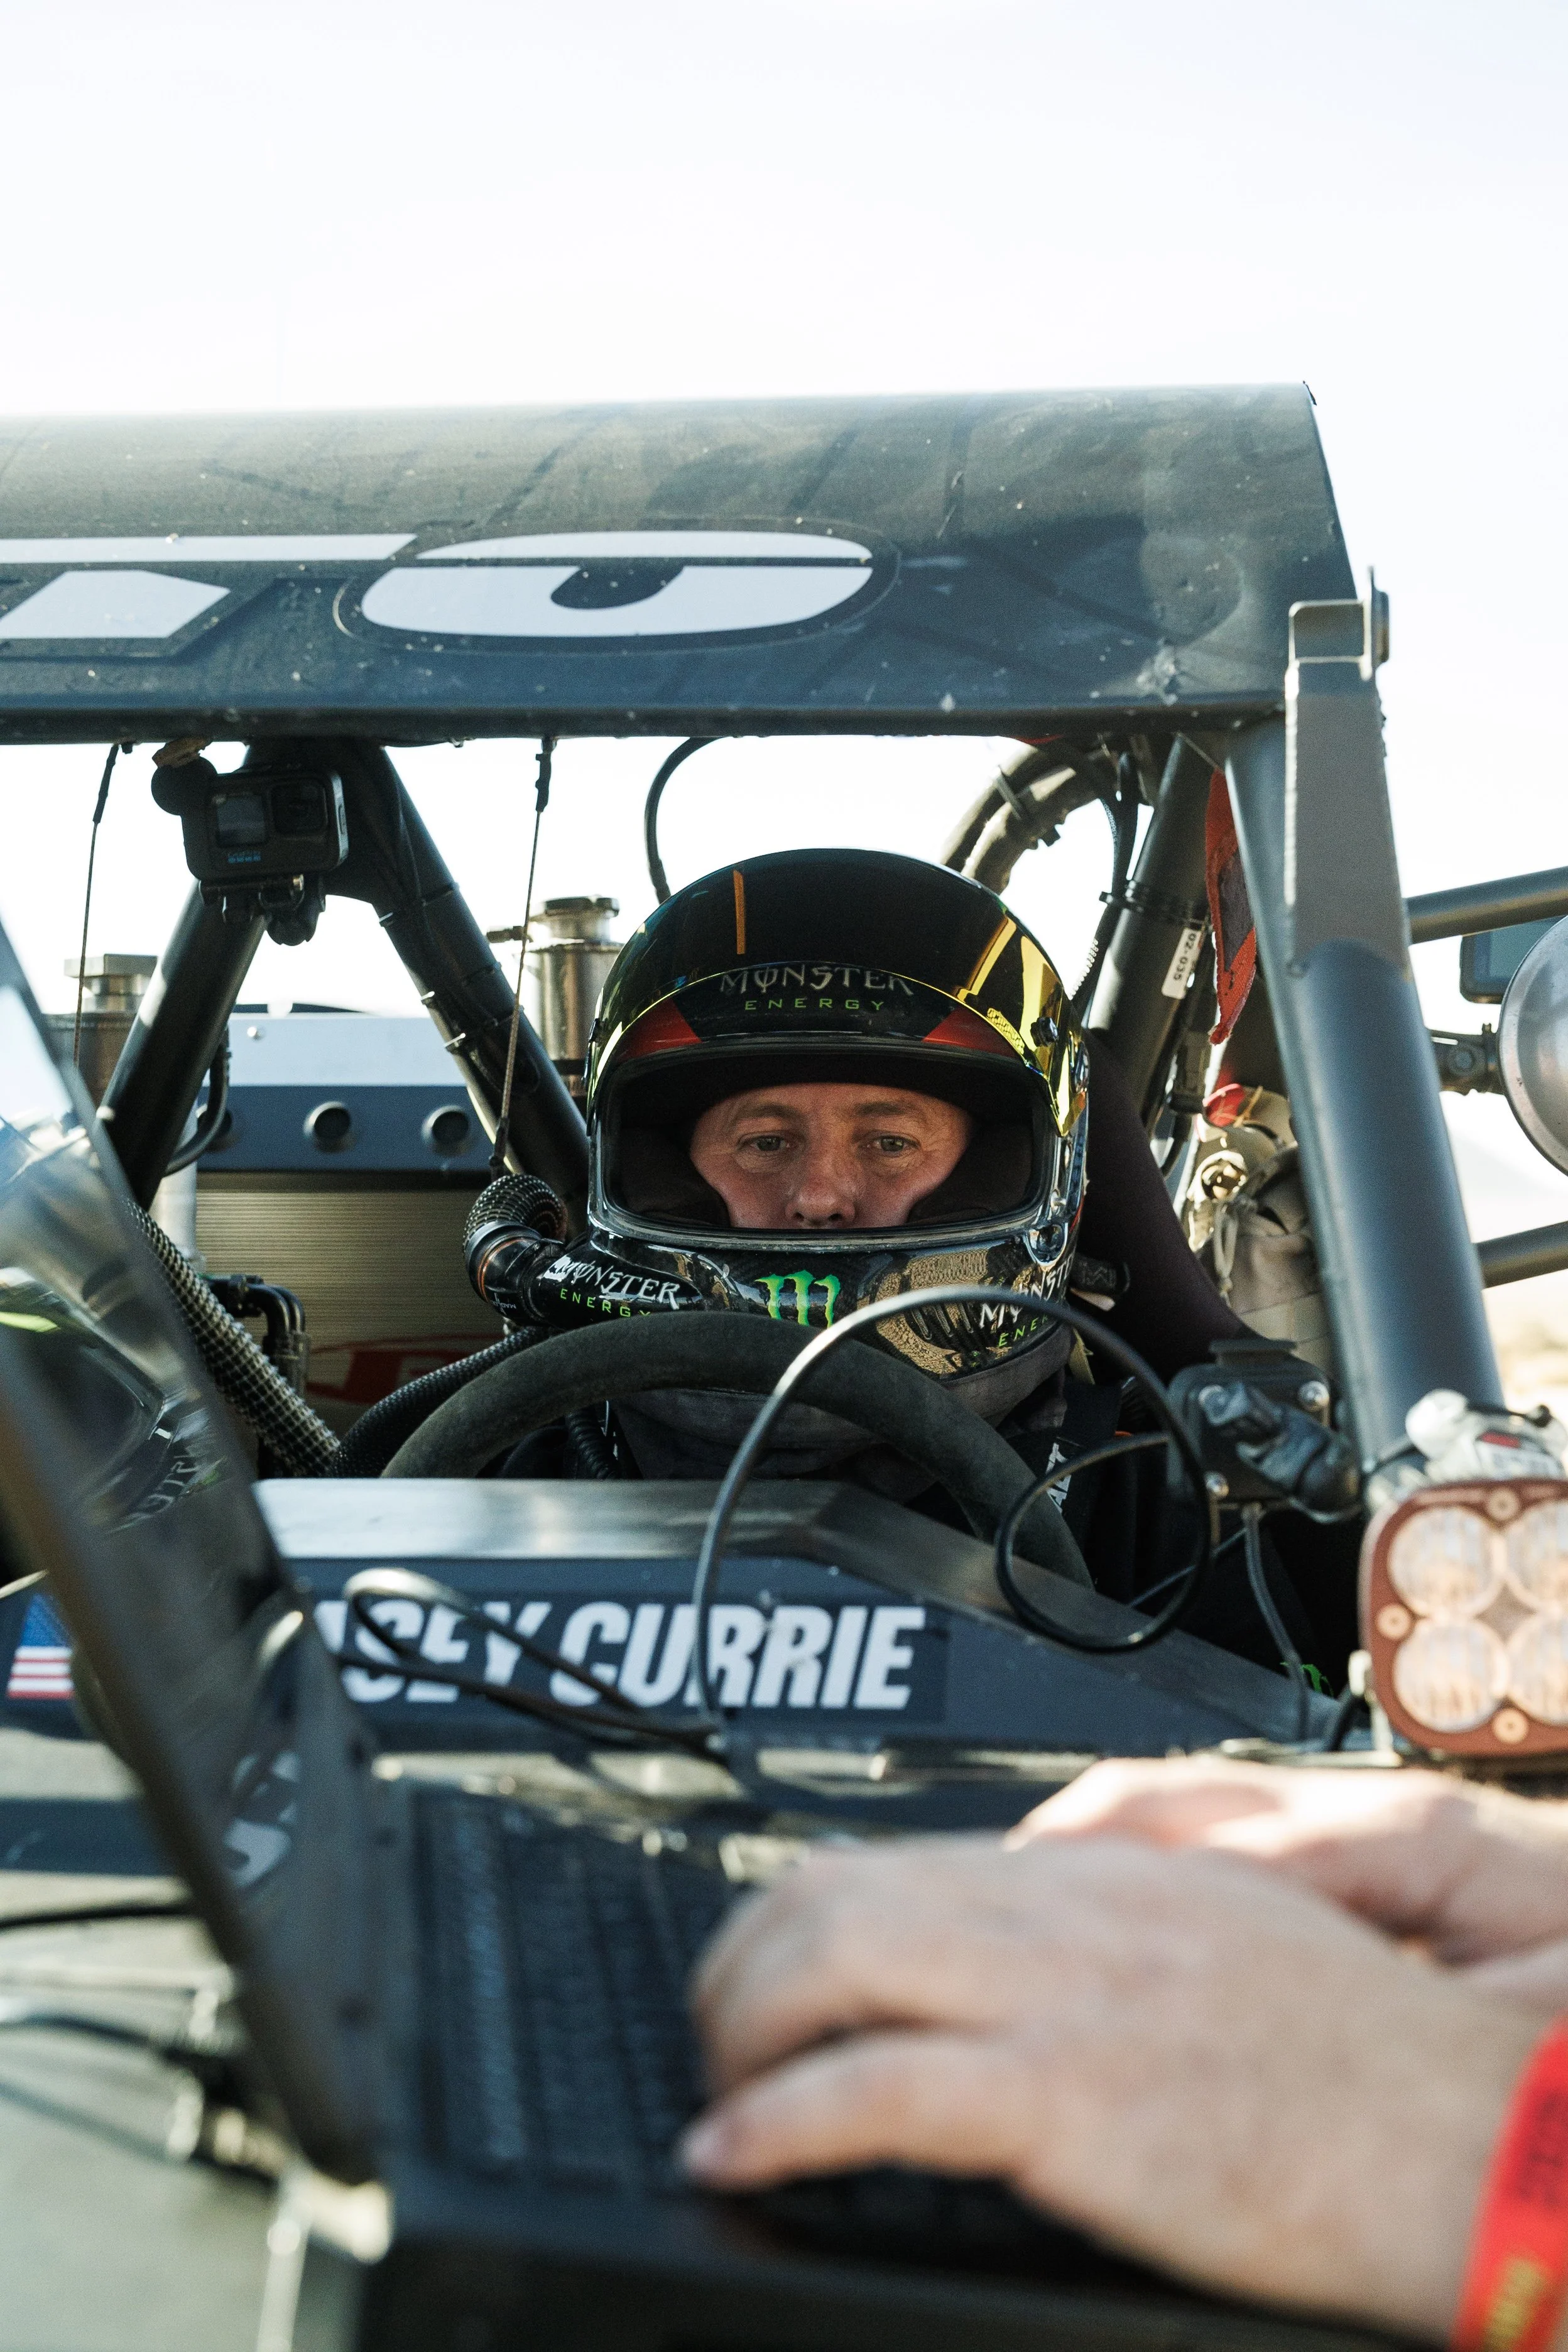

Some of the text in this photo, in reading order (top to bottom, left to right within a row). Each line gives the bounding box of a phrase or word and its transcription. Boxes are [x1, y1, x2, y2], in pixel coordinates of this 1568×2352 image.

[719, 964, 914, 996] MONSTER
[744, 998, 885, 1011] ENERGY
[313, 1600, 925, 1710] SEY CURRIE
